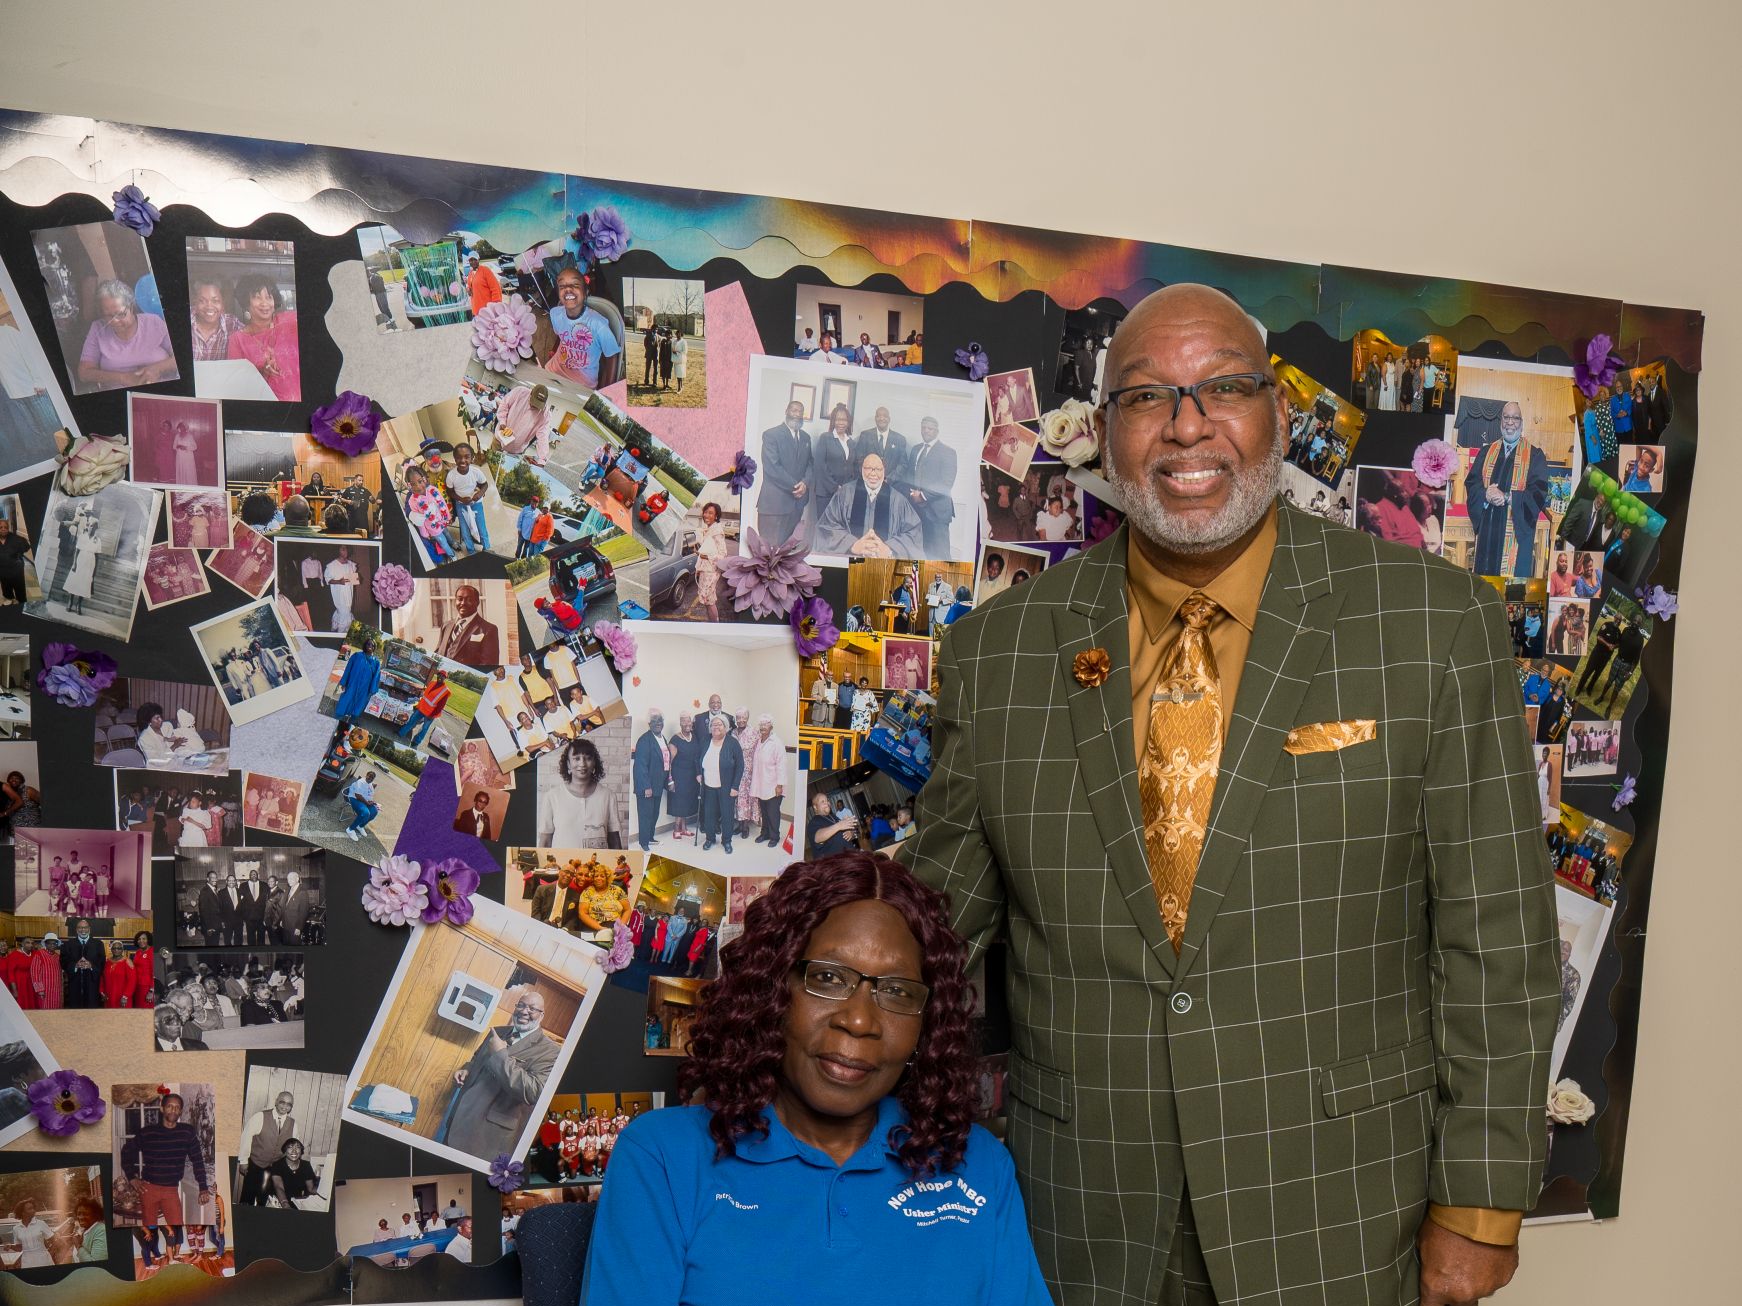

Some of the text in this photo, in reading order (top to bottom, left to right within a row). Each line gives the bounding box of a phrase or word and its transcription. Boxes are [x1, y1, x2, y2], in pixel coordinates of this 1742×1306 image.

[887, 1178, 986, 1210] New Hope MBC
[735, 1201, 759, 1210] Brown
[902, 1202, 979, 1218] Usher Ministry
